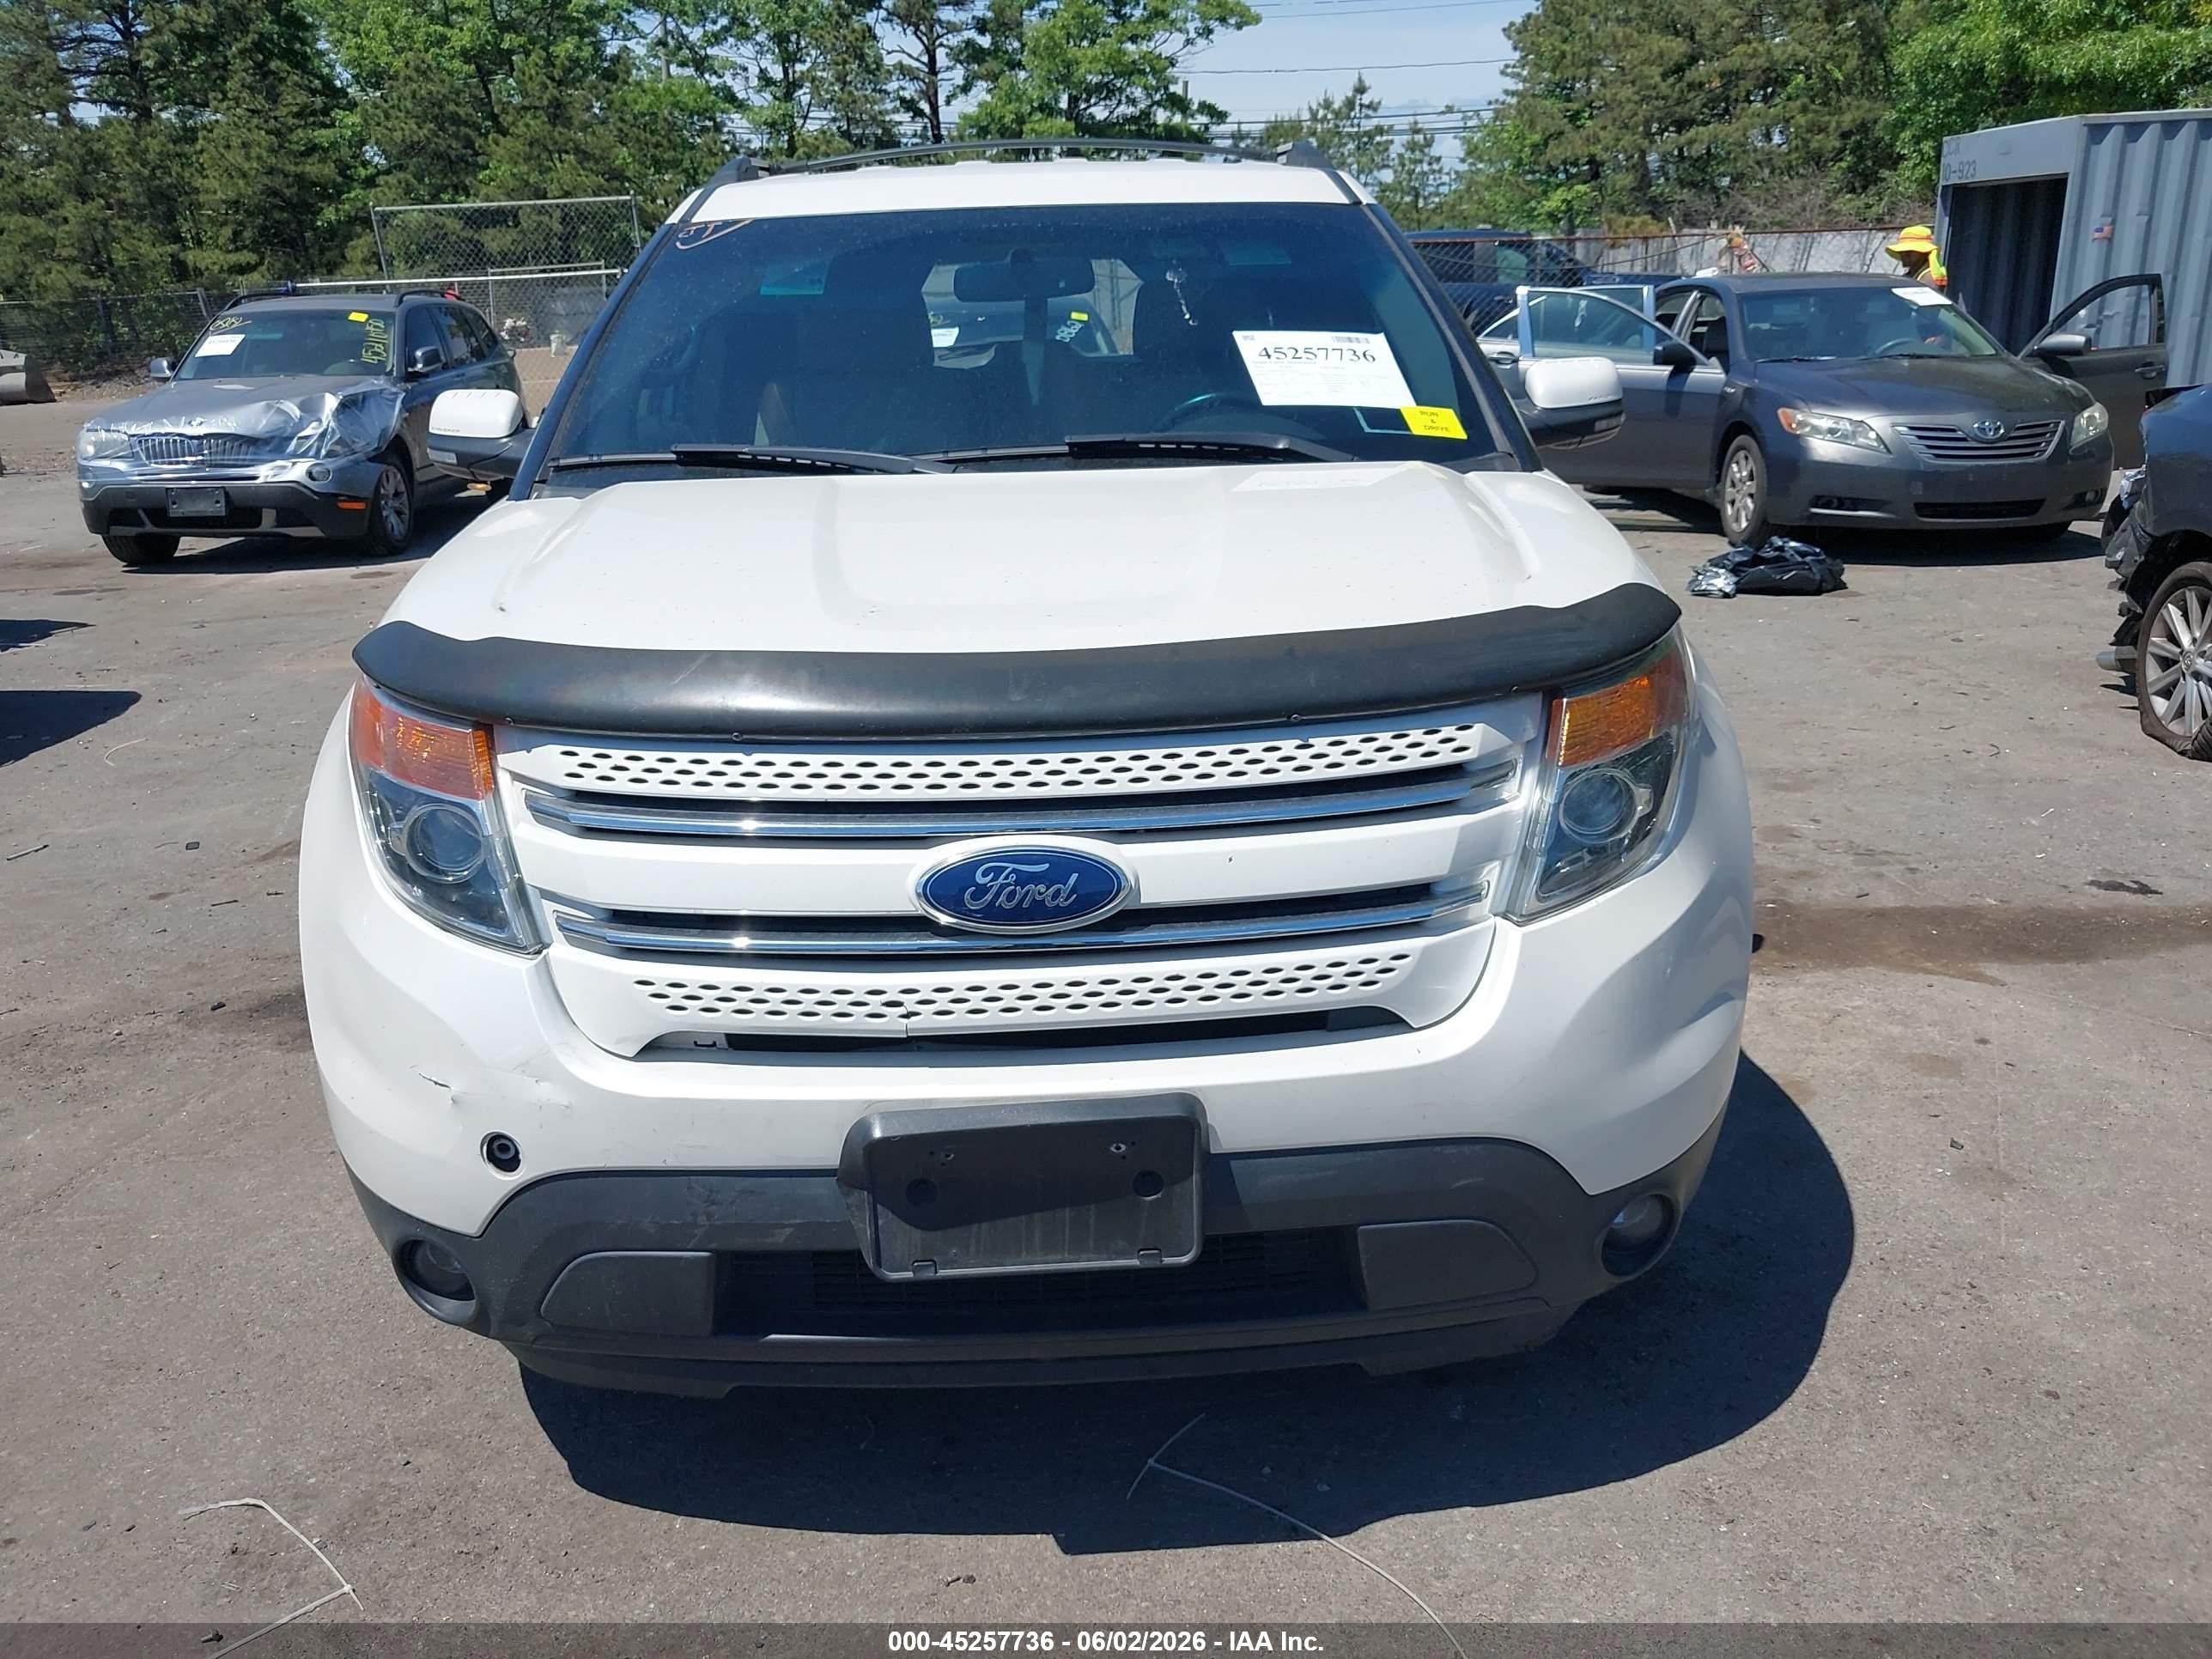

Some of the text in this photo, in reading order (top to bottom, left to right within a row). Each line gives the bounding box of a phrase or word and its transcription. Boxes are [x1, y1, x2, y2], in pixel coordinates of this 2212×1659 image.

[1257, 345, 1376, 363] 45257736
[1419, 410, 1439, 418] RUN
[1423, 424, 1450, 433] DRIVE
[964, 861, 1080, 910] Ford
